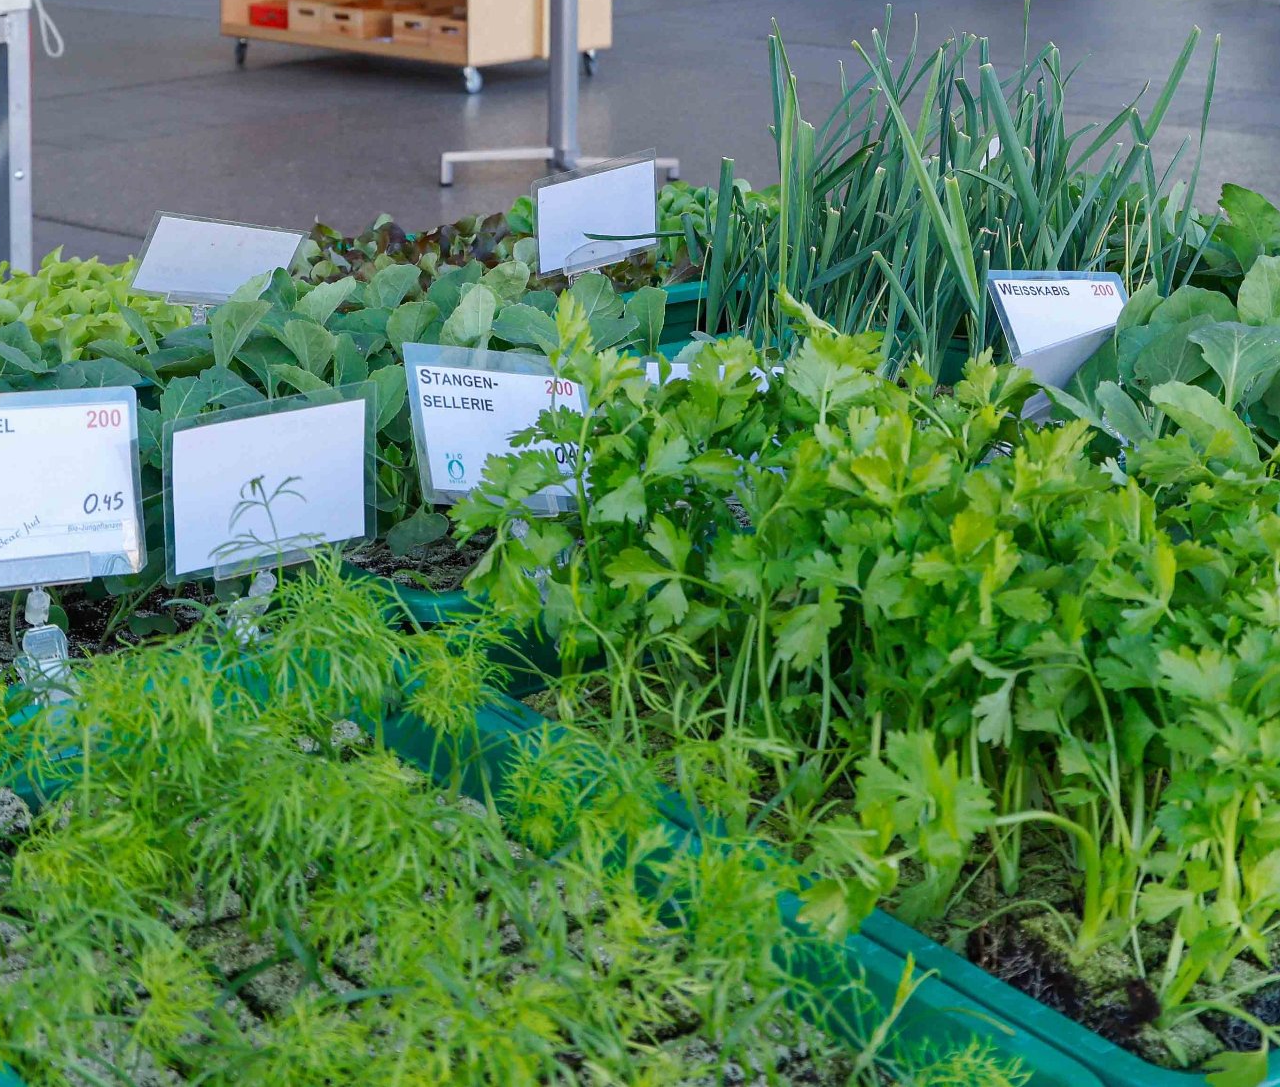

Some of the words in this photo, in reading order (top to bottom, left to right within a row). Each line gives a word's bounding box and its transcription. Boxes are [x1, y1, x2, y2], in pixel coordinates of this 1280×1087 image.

[998, 283, 1070, 296] WEISSKABIS
[1091, 284, 1114, 296] 200
[420, 368, 499, 390] STANGEN-
[544, 379, 573, 396] 200
[423, 394, 495, 412] SELLERIE
[86, 409, 121, 428] 200
[83, 491, 124, 515] 0.45
